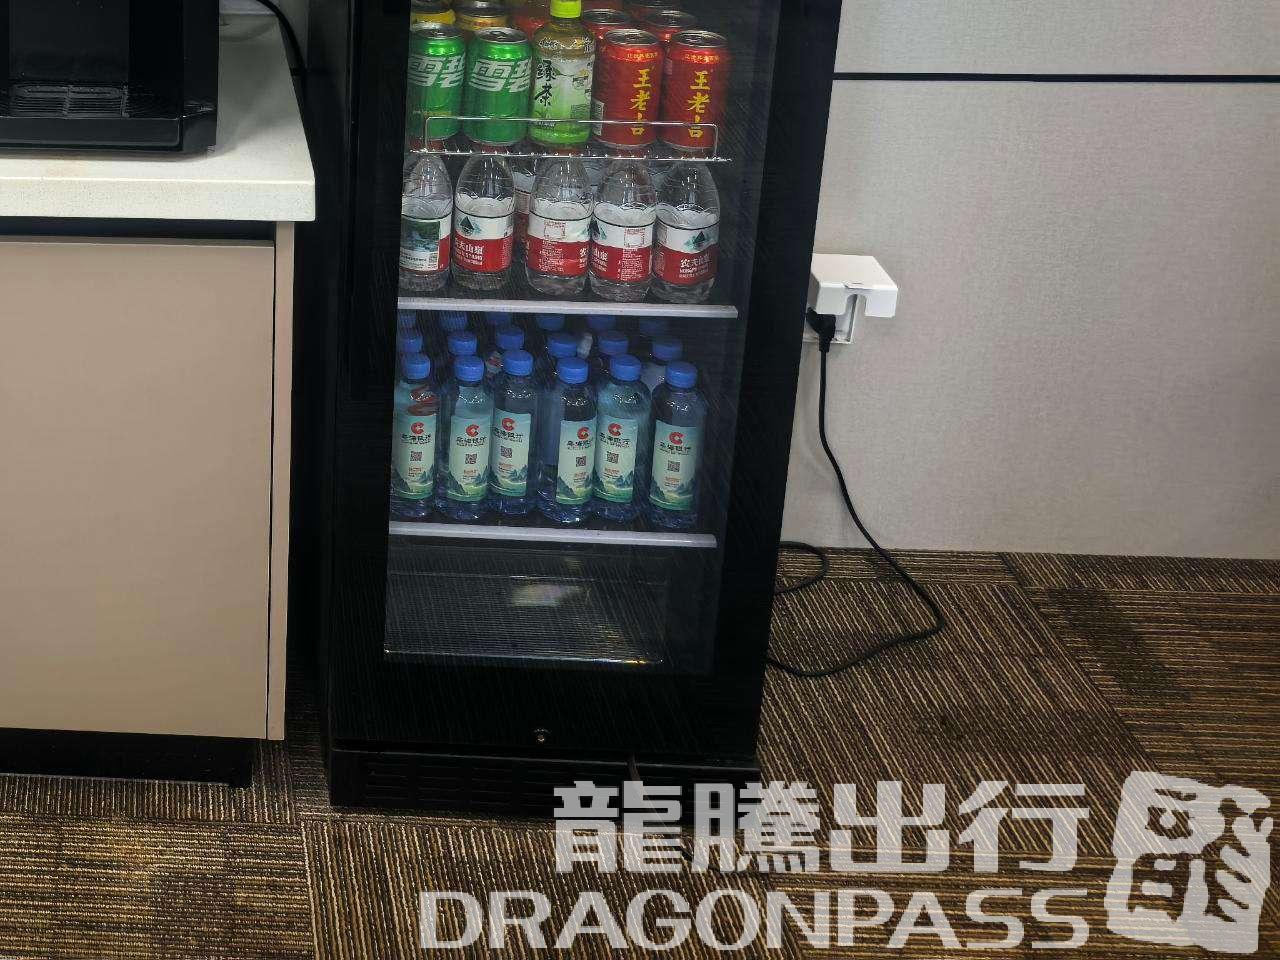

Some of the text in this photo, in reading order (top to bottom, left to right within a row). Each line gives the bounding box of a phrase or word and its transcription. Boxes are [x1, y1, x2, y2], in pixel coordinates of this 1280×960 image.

[629, 68, 652, 136] 王老吉
[687, 70, 710, 138] 王老吉
